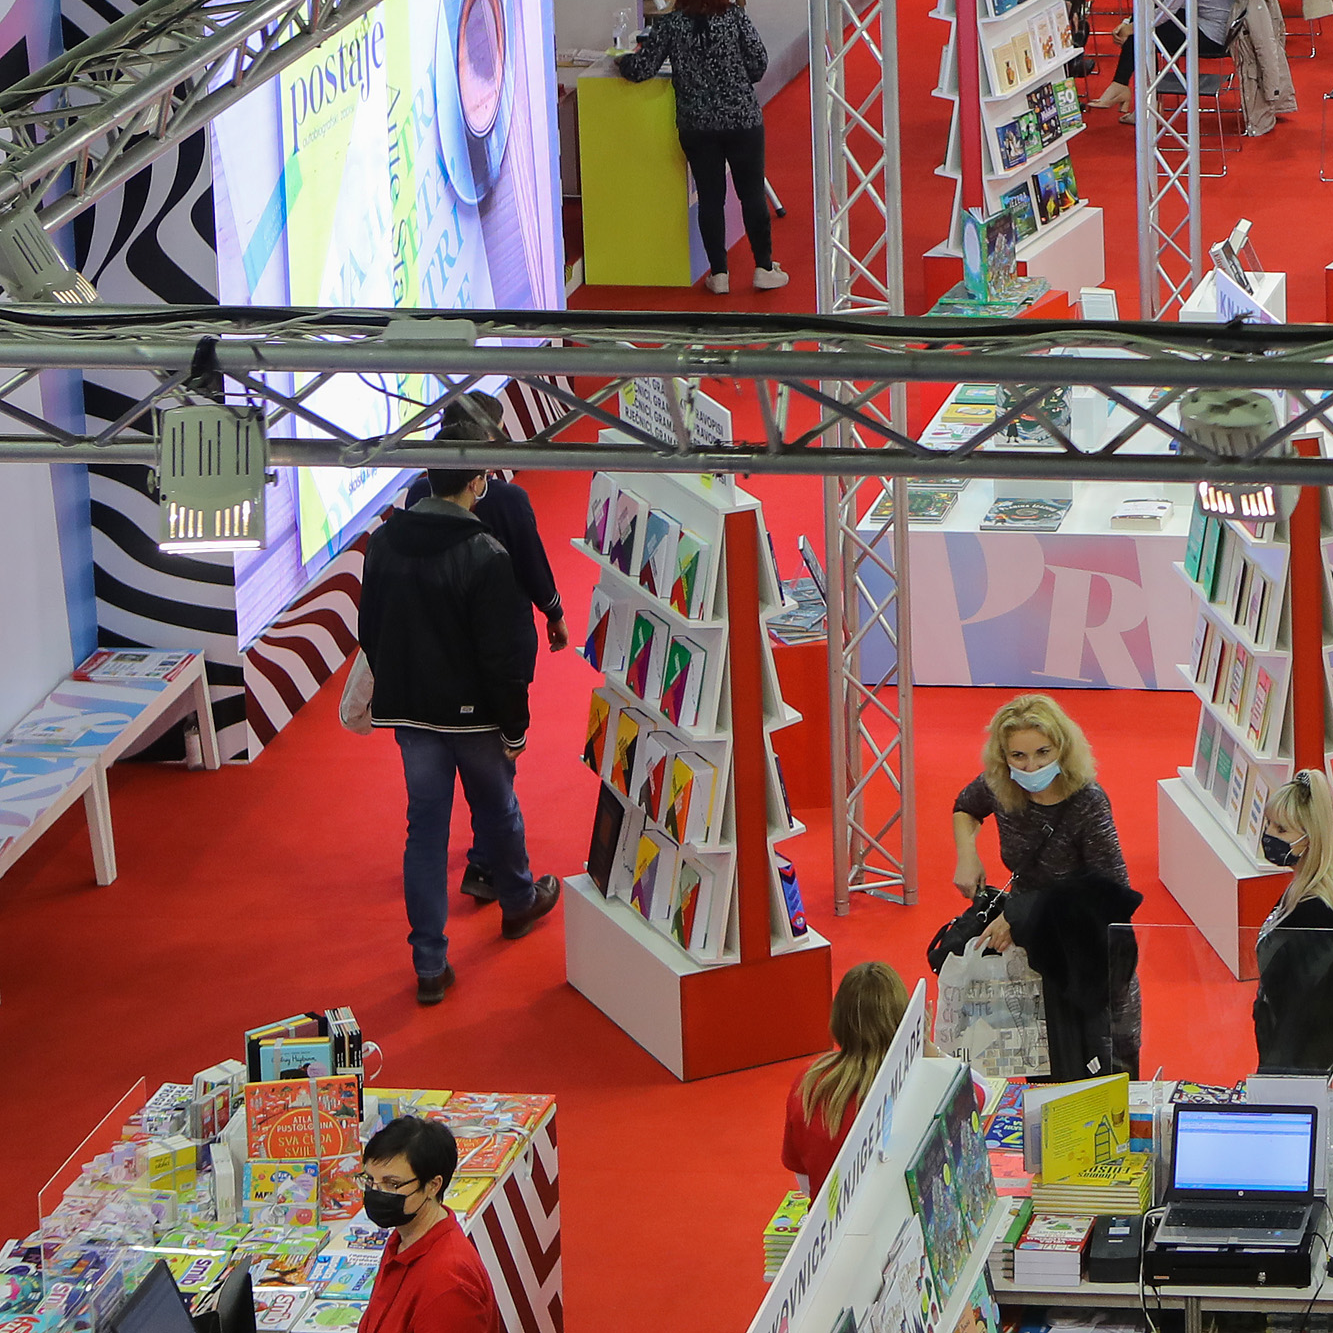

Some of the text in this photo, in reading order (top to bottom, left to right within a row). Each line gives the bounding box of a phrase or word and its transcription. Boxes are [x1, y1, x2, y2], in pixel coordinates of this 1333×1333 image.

[288, 21, 385, 157] postaje
[1057, 90, 1077, 108] 50
[276, 1121, 334, 1133] PUSTOLOINA
[292, 1116, 313, 1124] ATLA
[278, 1135, 299, 1147] SVA
[835, 1142, 875, 1229] KNJIGE
